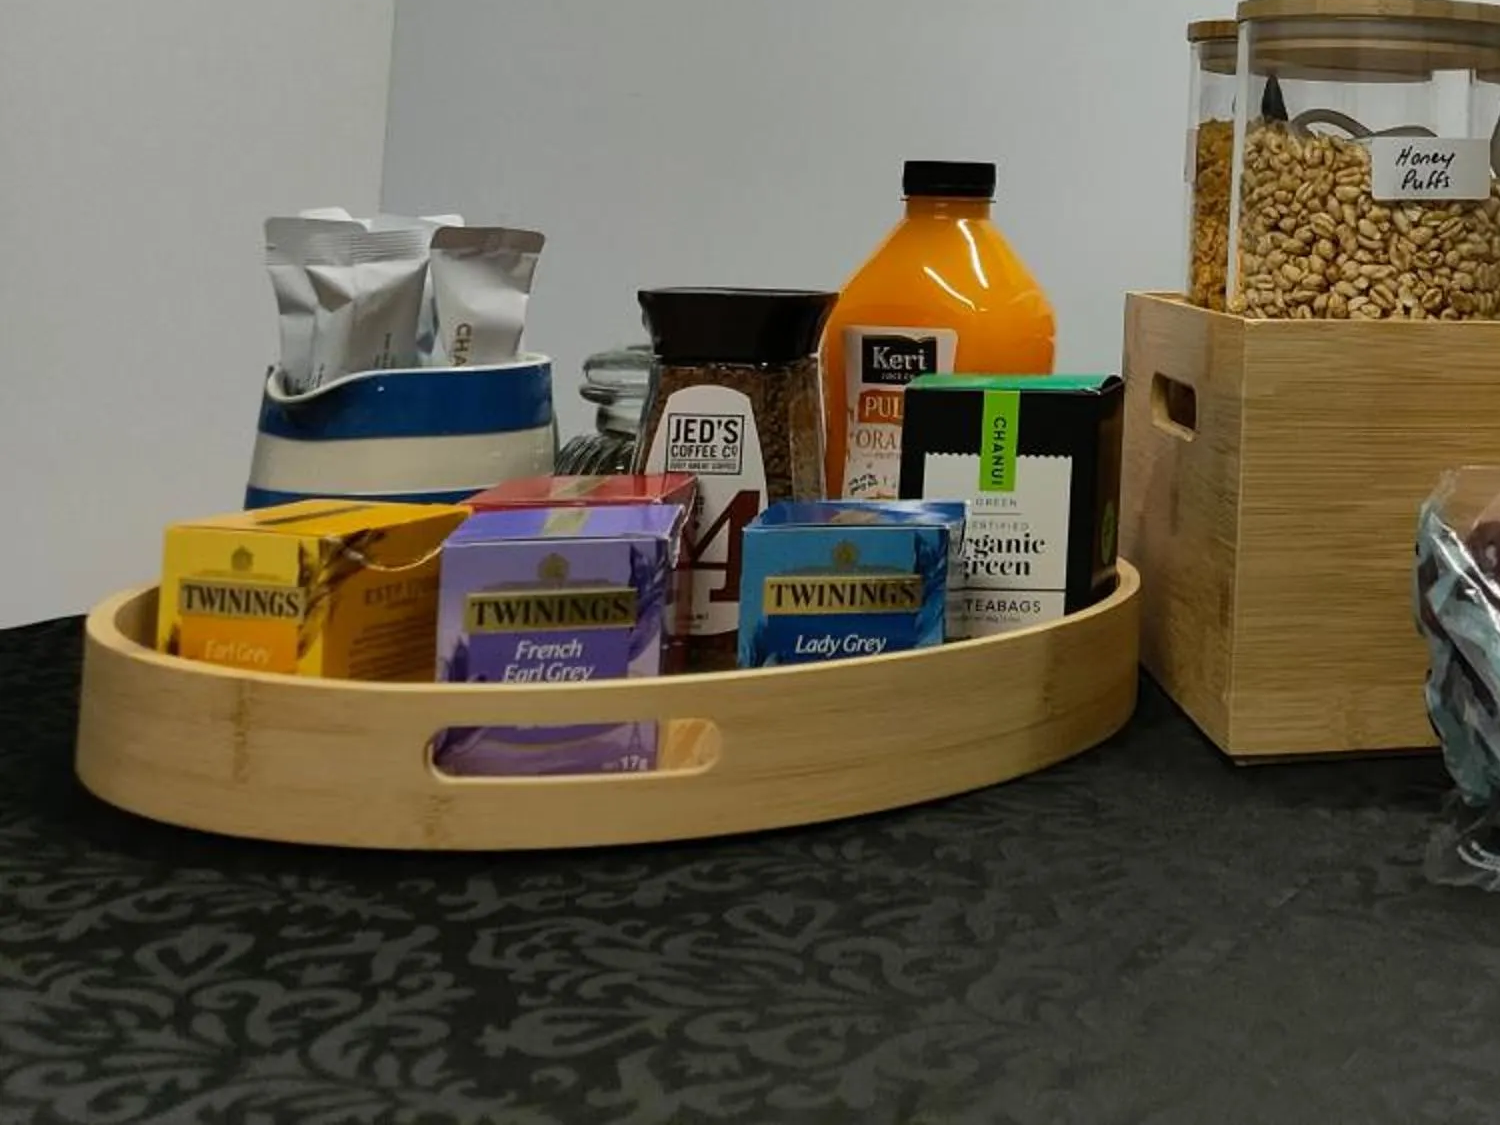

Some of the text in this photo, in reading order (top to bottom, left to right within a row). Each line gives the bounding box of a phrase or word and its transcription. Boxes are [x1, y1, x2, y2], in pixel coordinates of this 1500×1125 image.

[1395, 145, 1456, 169] Honey
[1401, 169, 1450, 190] Puffs
[872, 346, 928, 370] Keri
[865, 396, 903, 418] PUL
[671, 418, 739, 444] JED'S
[855, 428, 897, 450] ORA
[671, 444, 718, 458] COFFEE
[992, 416, 1007, 486] CHANUI
[975, 498, 1017, 507] GREEN
[967, 533, 1046, 557] rganic
[184, 584, 300, 618] TWININGS
[769, 582, 917, 607] TWININGS
[965, 598, 1042, 613] TEABAGS
[471, 598, 630, 626] TWININGS
[204, 639, 234, 662] Earl
[515, 638, 582, 661] French
[795, 634, 887, 658] Lady Grey
[504, 661, 597, 683] Earl Grey
